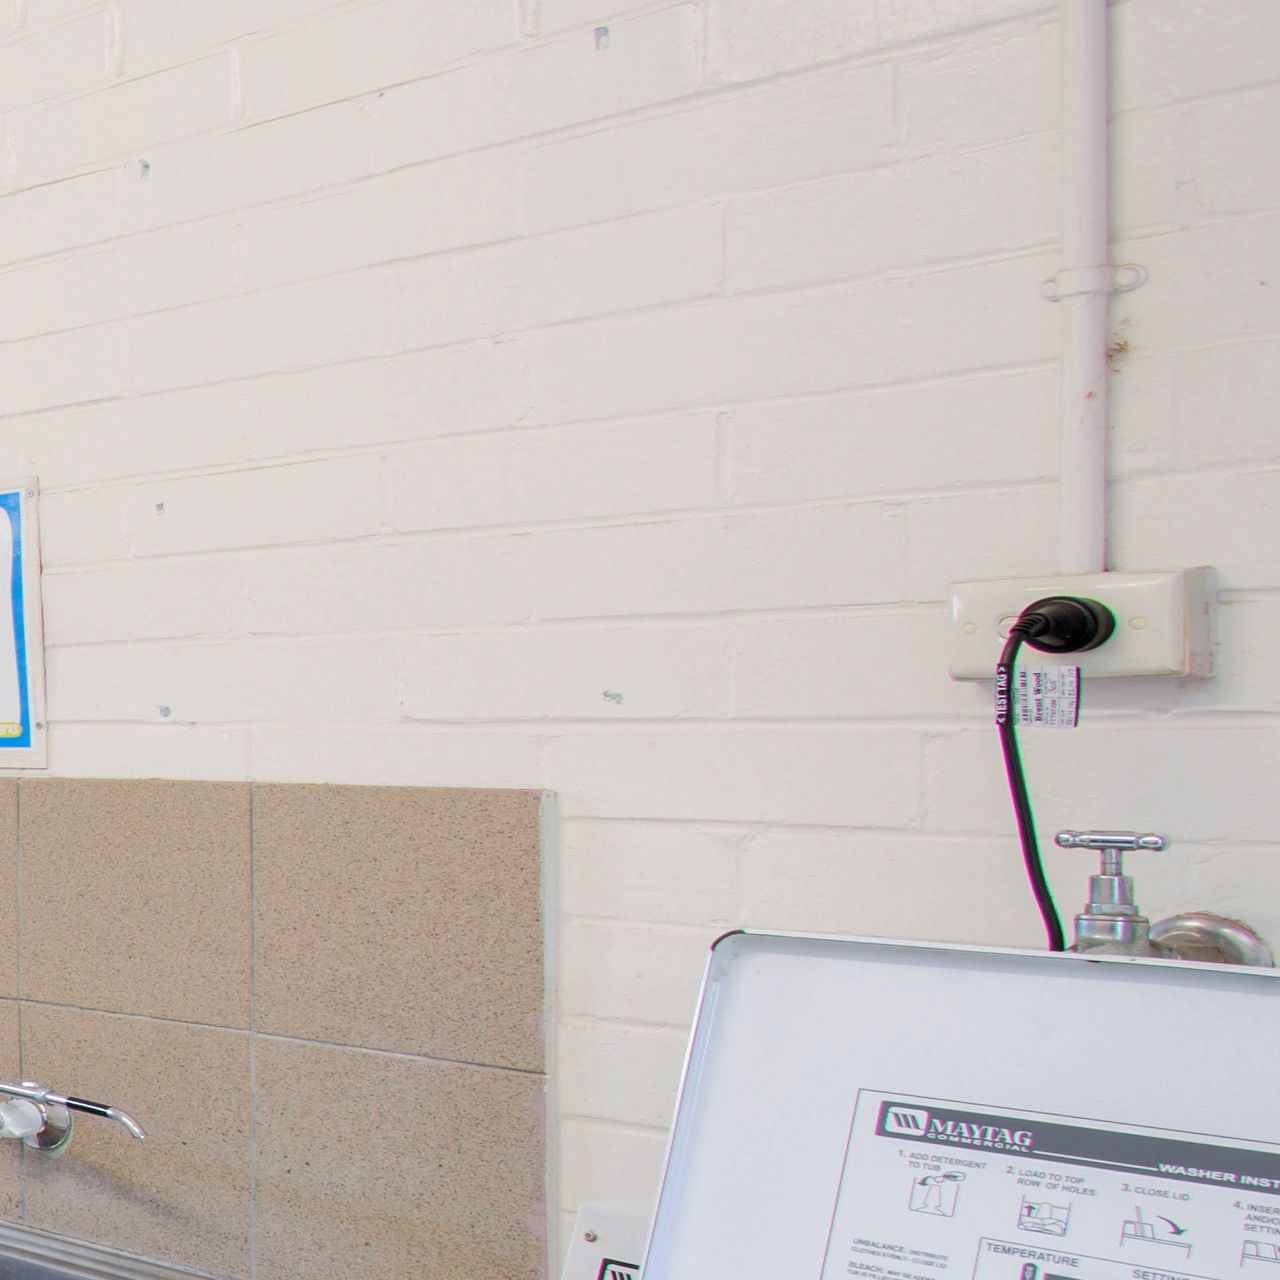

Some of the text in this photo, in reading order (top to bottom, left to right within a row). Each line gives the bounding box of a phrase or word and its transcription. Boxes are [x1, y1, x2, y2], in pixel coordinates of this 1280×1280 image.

[997, 673, 1008, 715] TEST TAG
[927, 1117, 1034, 1146] MAYTAG
[925, 1131, 1031, 1153] COMMERCIAL
[896, 1149, 987, 1170] 1. ADD DETERGENT
[907, 1160, 941, 1171] TO TUB
[1004, 1165, 1085, 1185] 2. LOAD TO TOP
[1155, 1162, 1238, 1183] WASHER
[1016, 1177, 1096, 1196] ROW OF HOLES
[1120, 1182, 1190, 1202] 3. CLOSE LID
[852, 1237, 905, 1253] UNBALANCE:
[985, 1242, 1079, 1267] TEMPERATURE
[847, 1260, 884, 1273] BLEACH:
